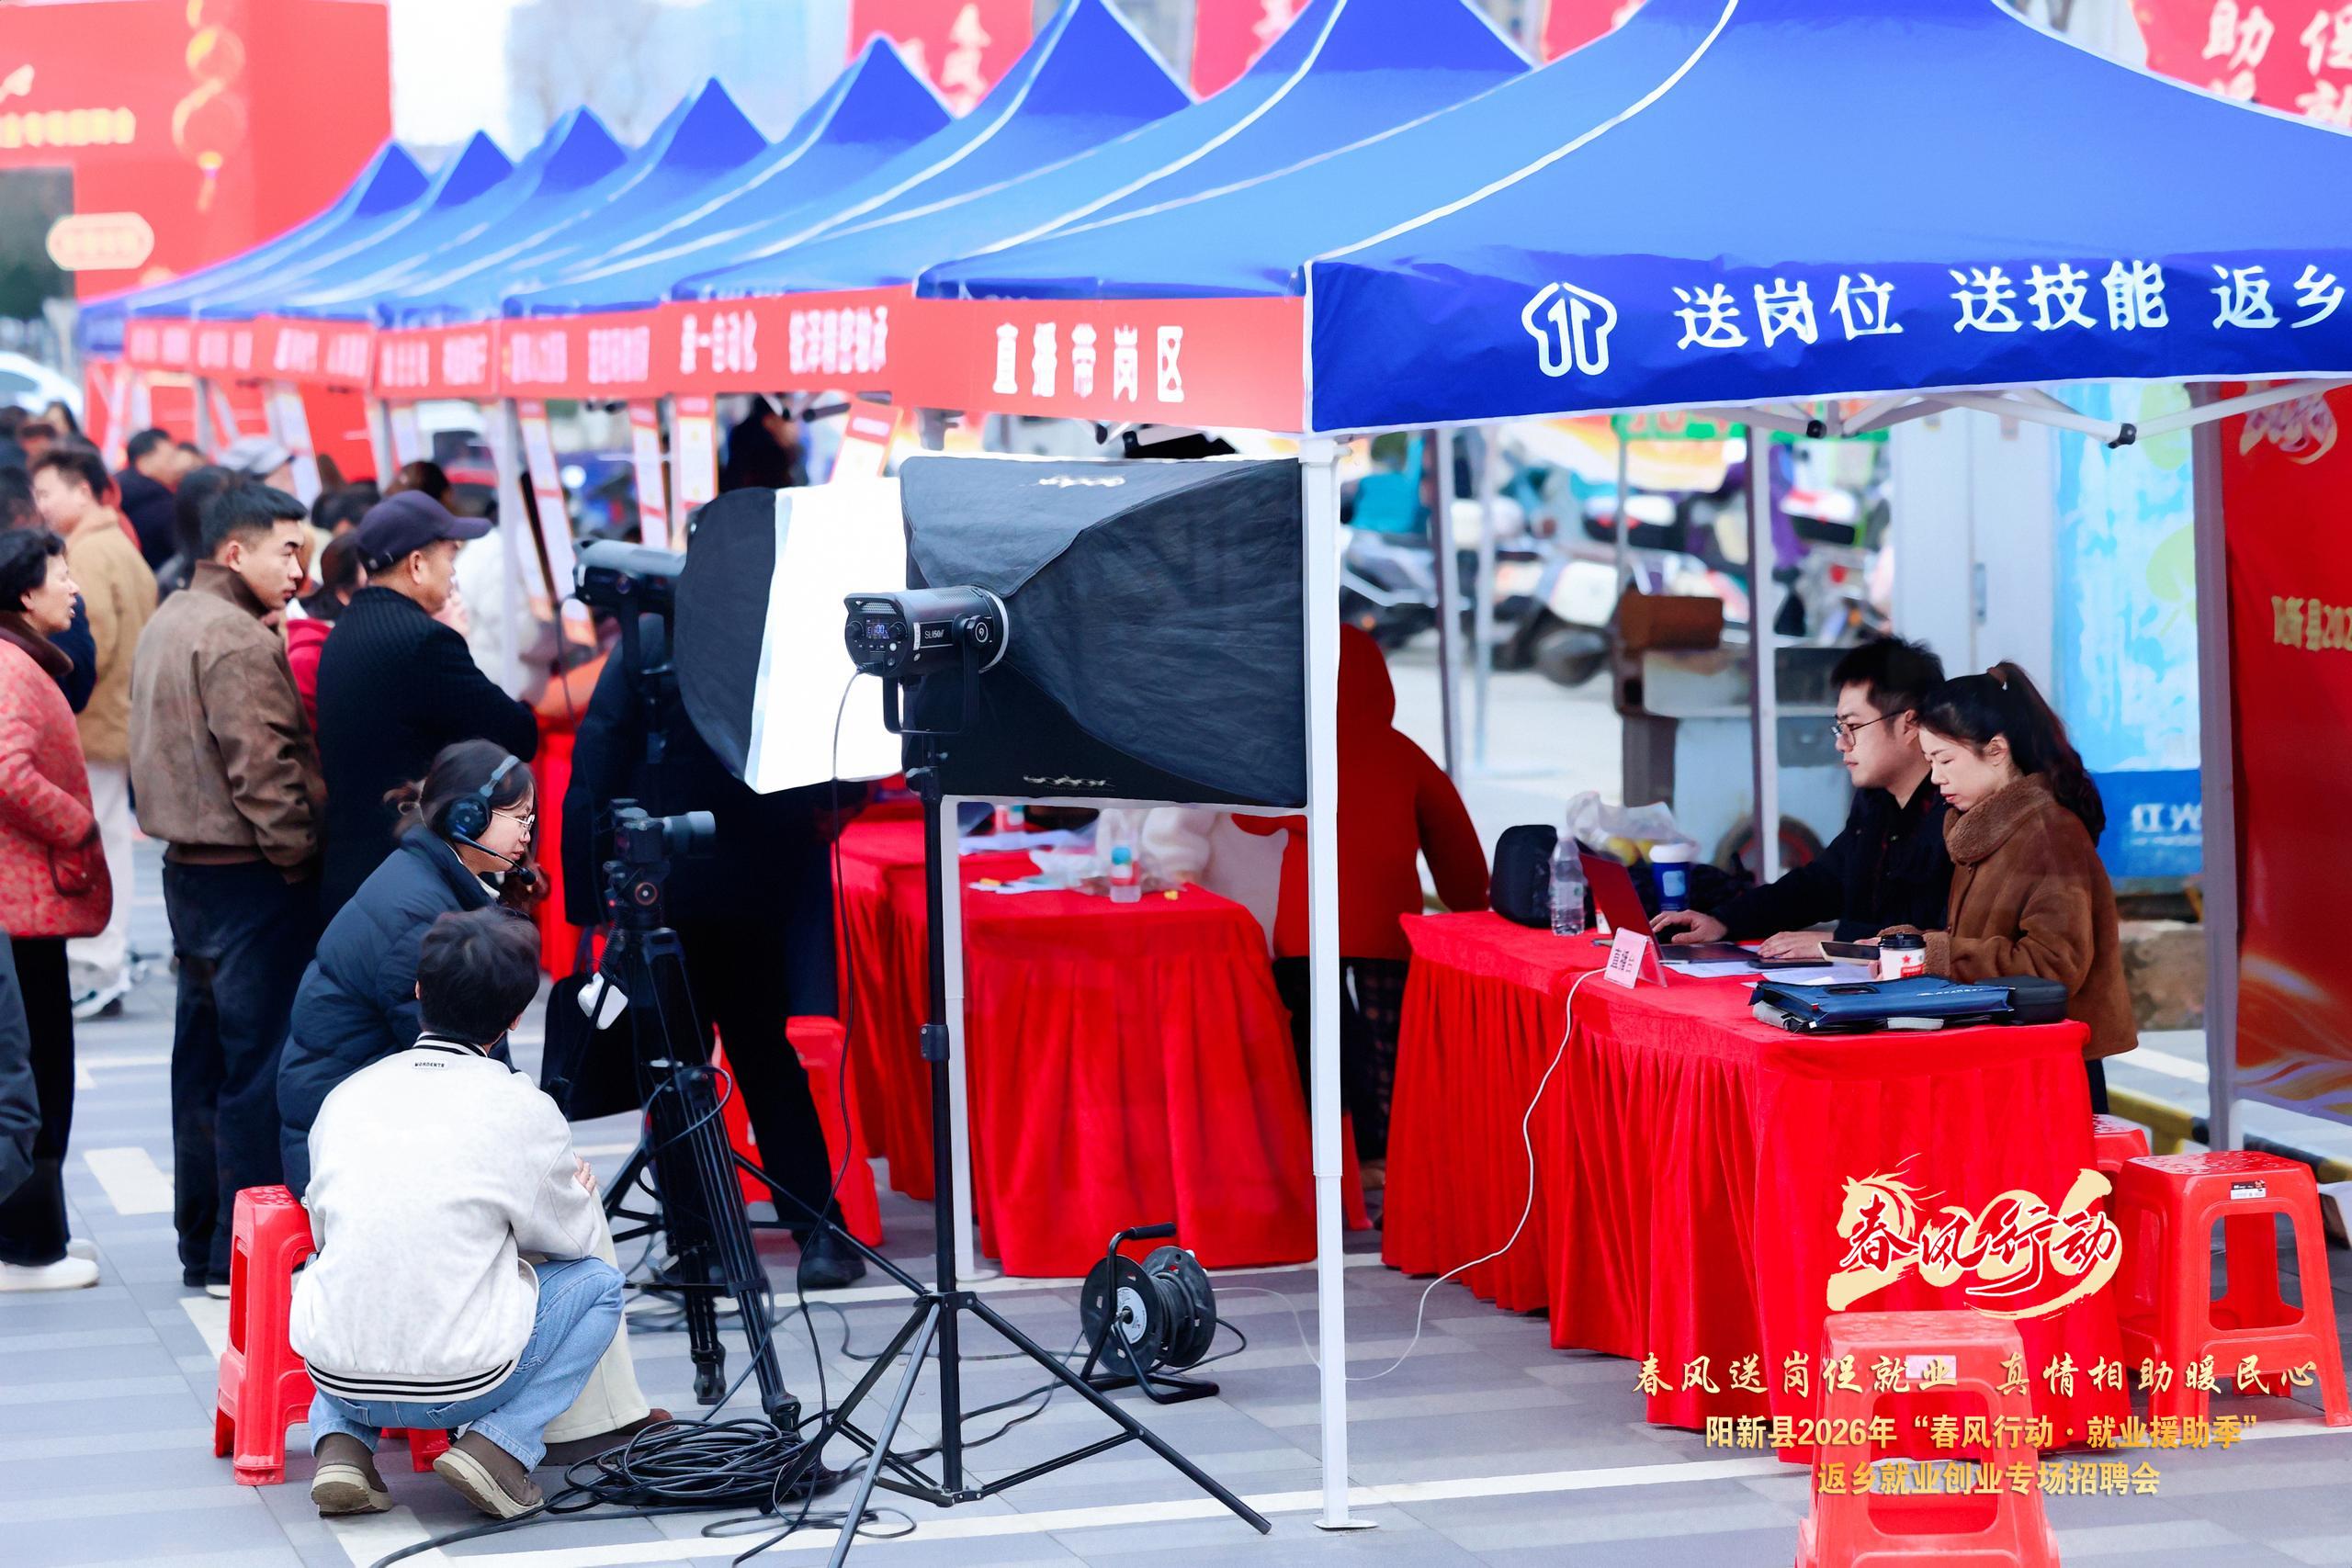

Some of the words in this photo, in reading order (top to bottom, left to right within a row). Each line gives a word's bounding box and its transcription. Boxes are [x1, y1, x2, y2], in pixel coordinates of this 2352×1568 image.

[1674, 275, 1904, 350] 送岗位
[1951, 260, 2169, 333] 送技能
[2212, 265, 2346, 329] 返乡
[993, 321, 1185, 403] 直播带岗区
